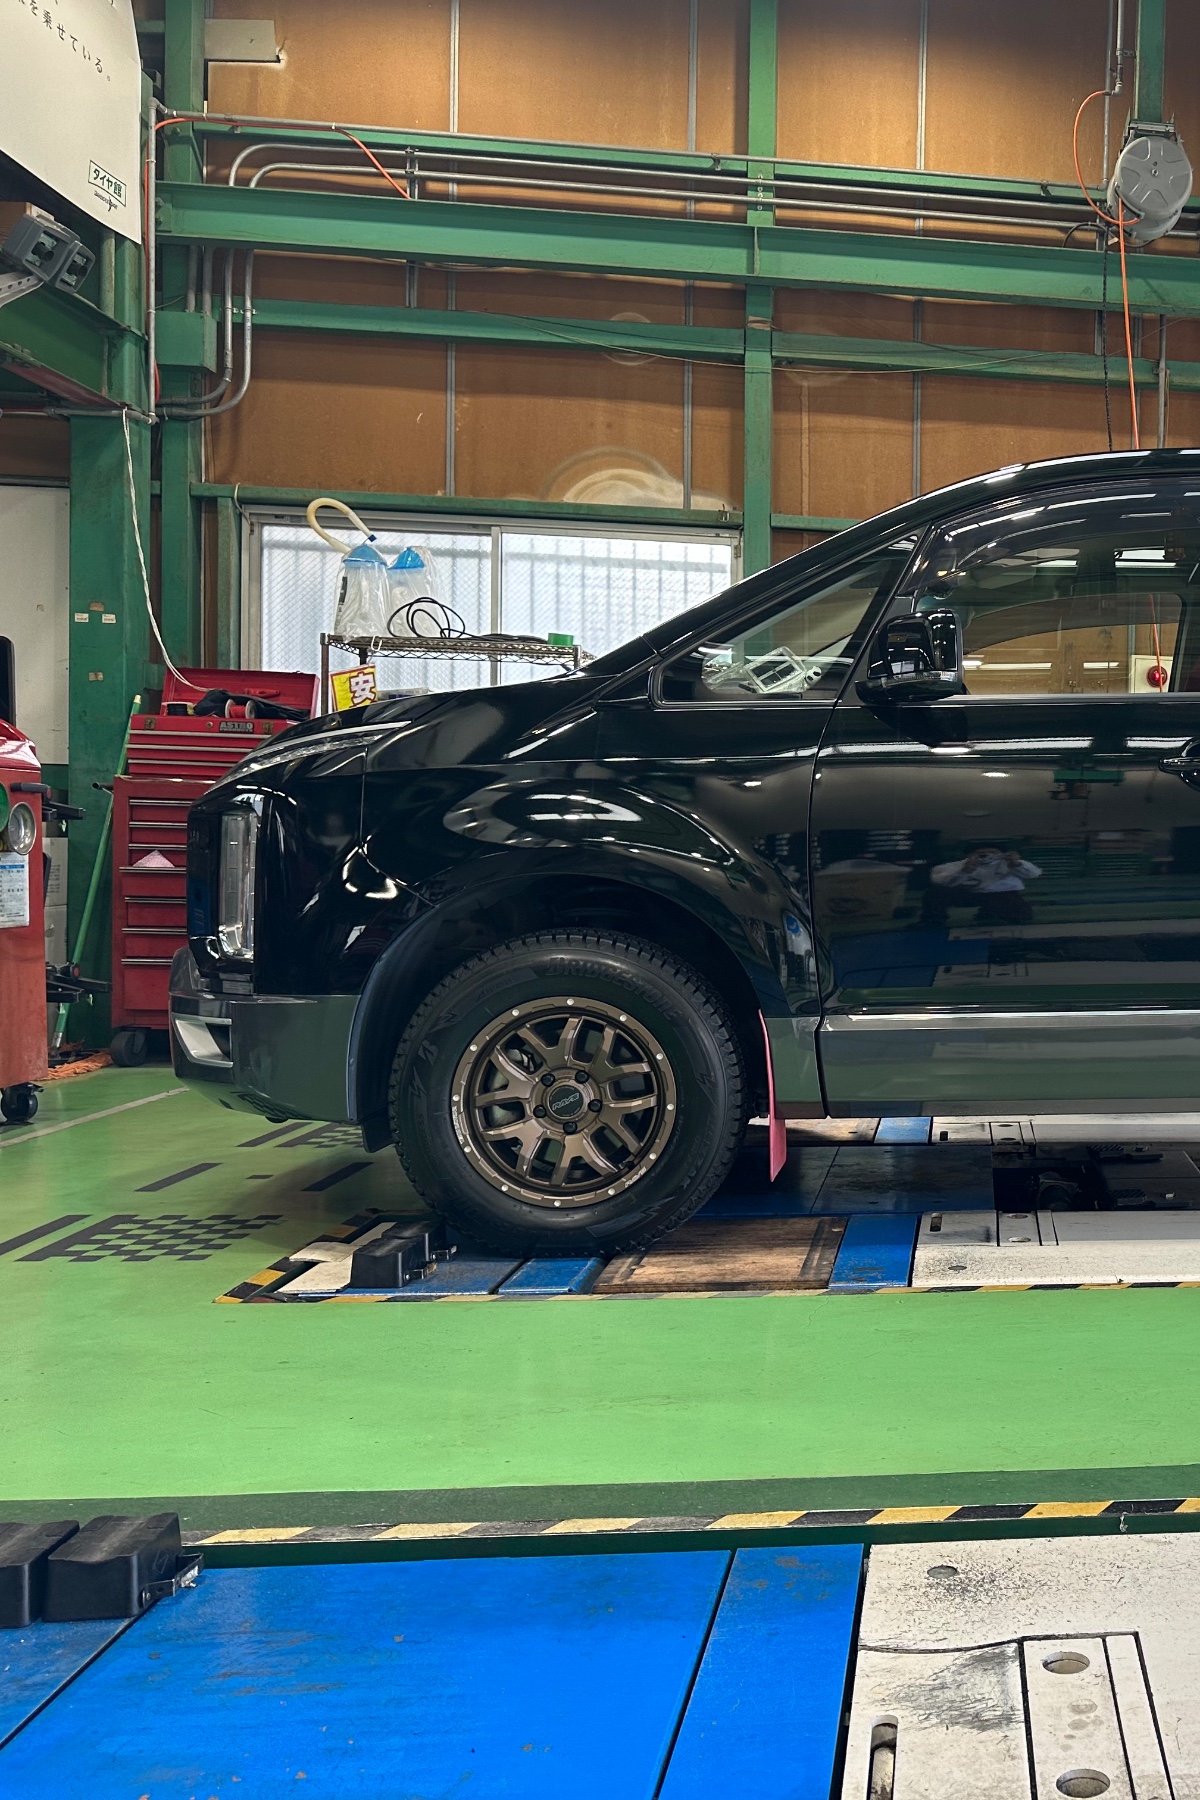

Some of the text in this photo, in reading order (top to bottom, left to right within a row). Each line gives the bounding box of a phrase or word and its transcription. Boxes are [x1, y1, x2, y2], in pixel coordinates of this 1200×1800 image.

[19, 0, 111, 81] を乗せている。
[93, 168, 123, 198] タイヤ館
[349, 671, 377, 708] 安
[220, 721, 254, 730] ASTRO
